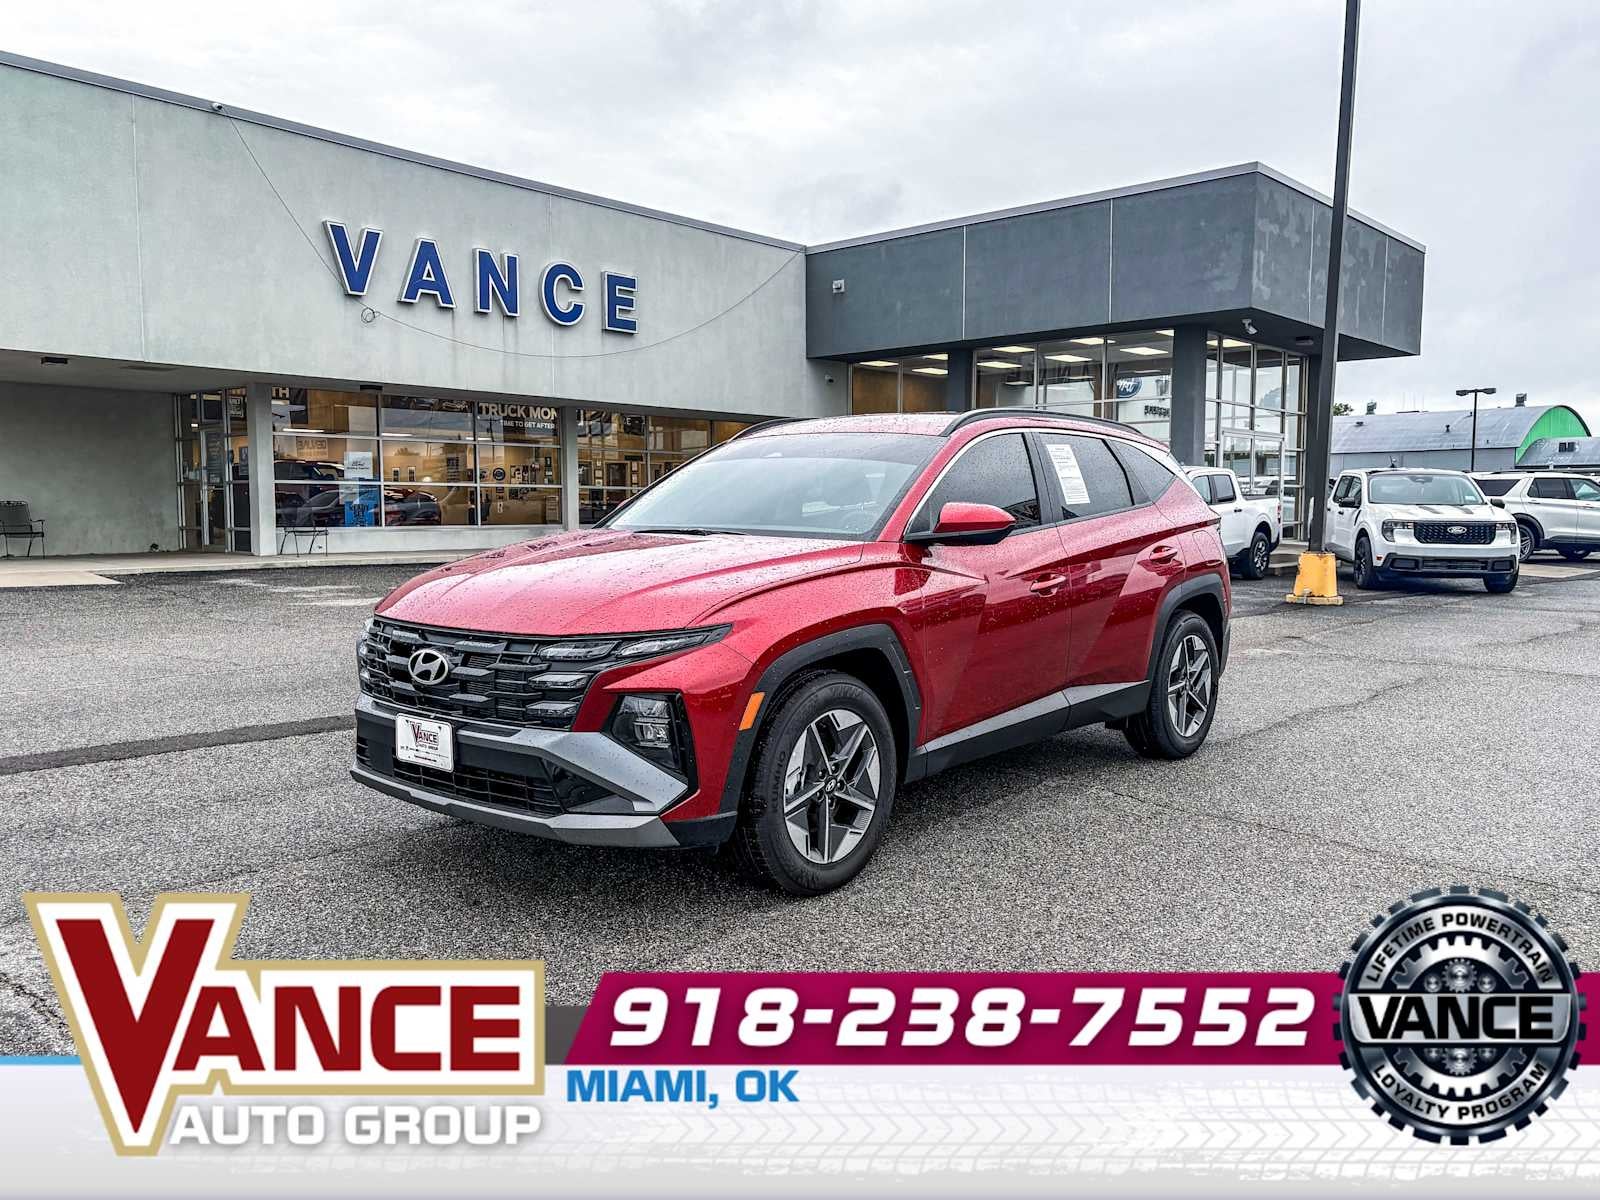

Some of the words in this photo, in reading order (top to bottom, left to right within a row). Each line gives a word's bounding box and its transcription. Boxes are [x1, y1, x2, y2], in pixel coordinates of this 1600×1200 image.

[322, 219, 638, 335] VANCE
[479, 403, 526, 418] TRUCK
[410, 722, 438, 744] VANCE
